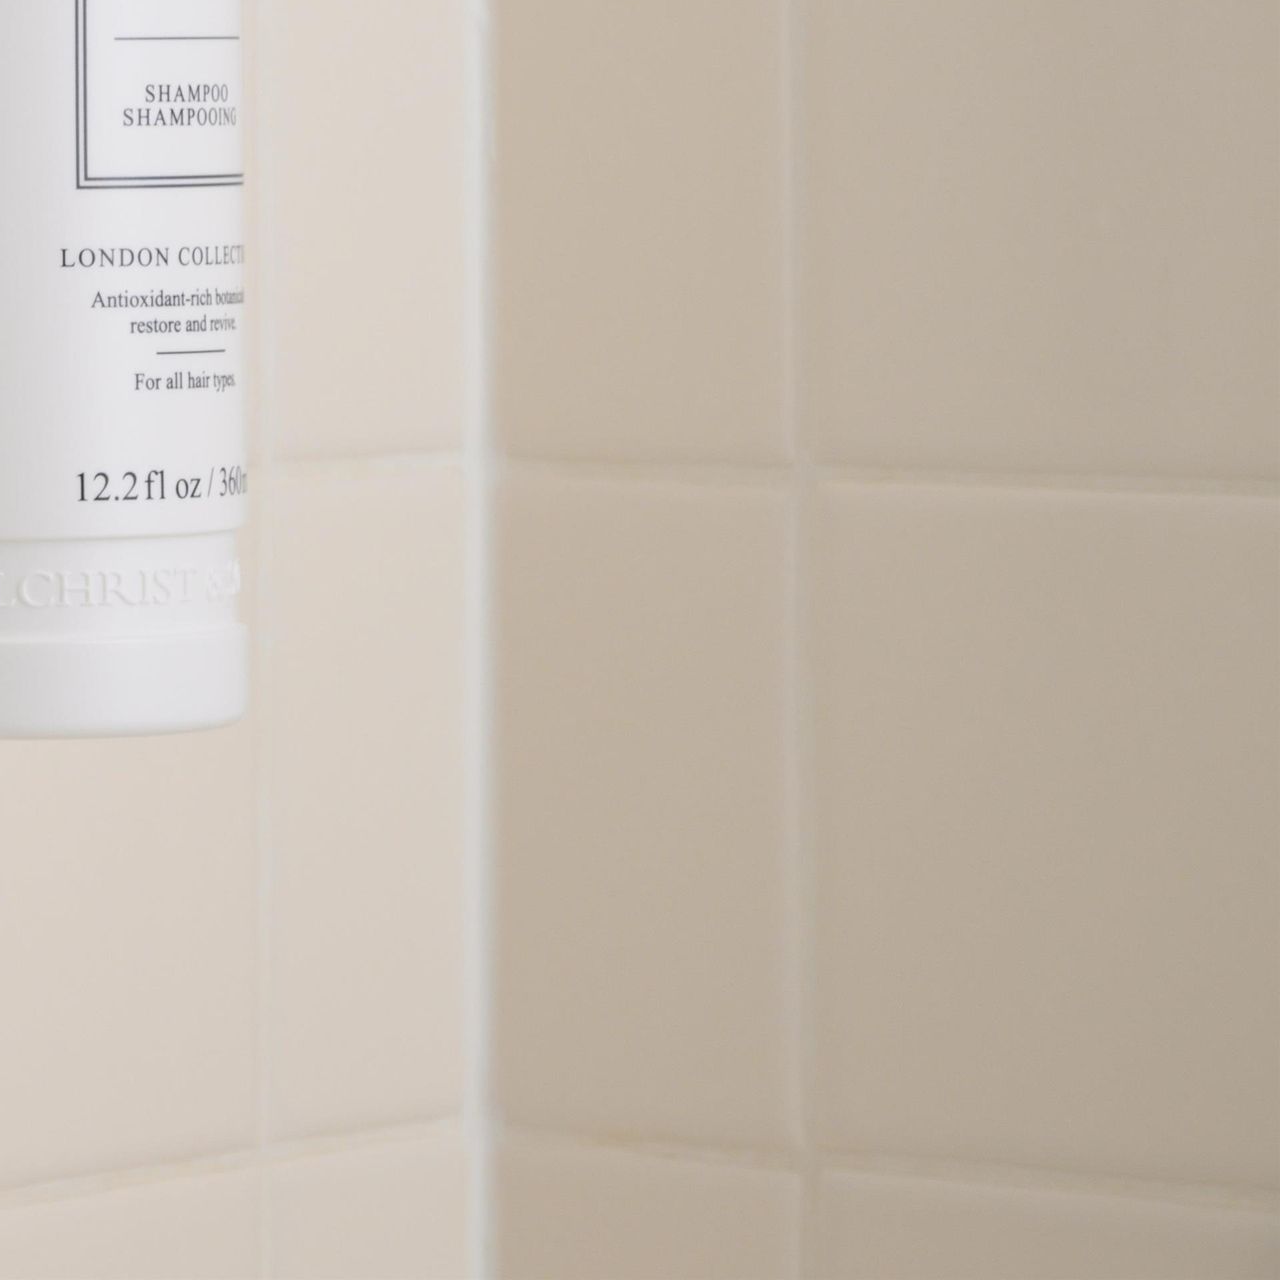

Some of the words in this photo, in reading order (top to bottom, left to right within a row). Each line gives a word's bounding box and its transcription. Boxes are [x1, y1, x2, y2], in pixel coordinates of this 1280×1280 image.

[145, 84, 228, 103] SHAMPOO
[123, 107, 237, 127] SHAMPOOING
[60, 247, 170, 268] LONDON
[91, 288, 212, 308] Antioxidant-rich
[130, 318, 182, 334] restore
[186, 315, 207, 333] and
[134, 373, 162, 391] For
[166, 372, 183, 390] all
[188, 371, 211, 389] hair
[76, 471, 139, 502] 12.2
[175, 476, 202, 499] oz
